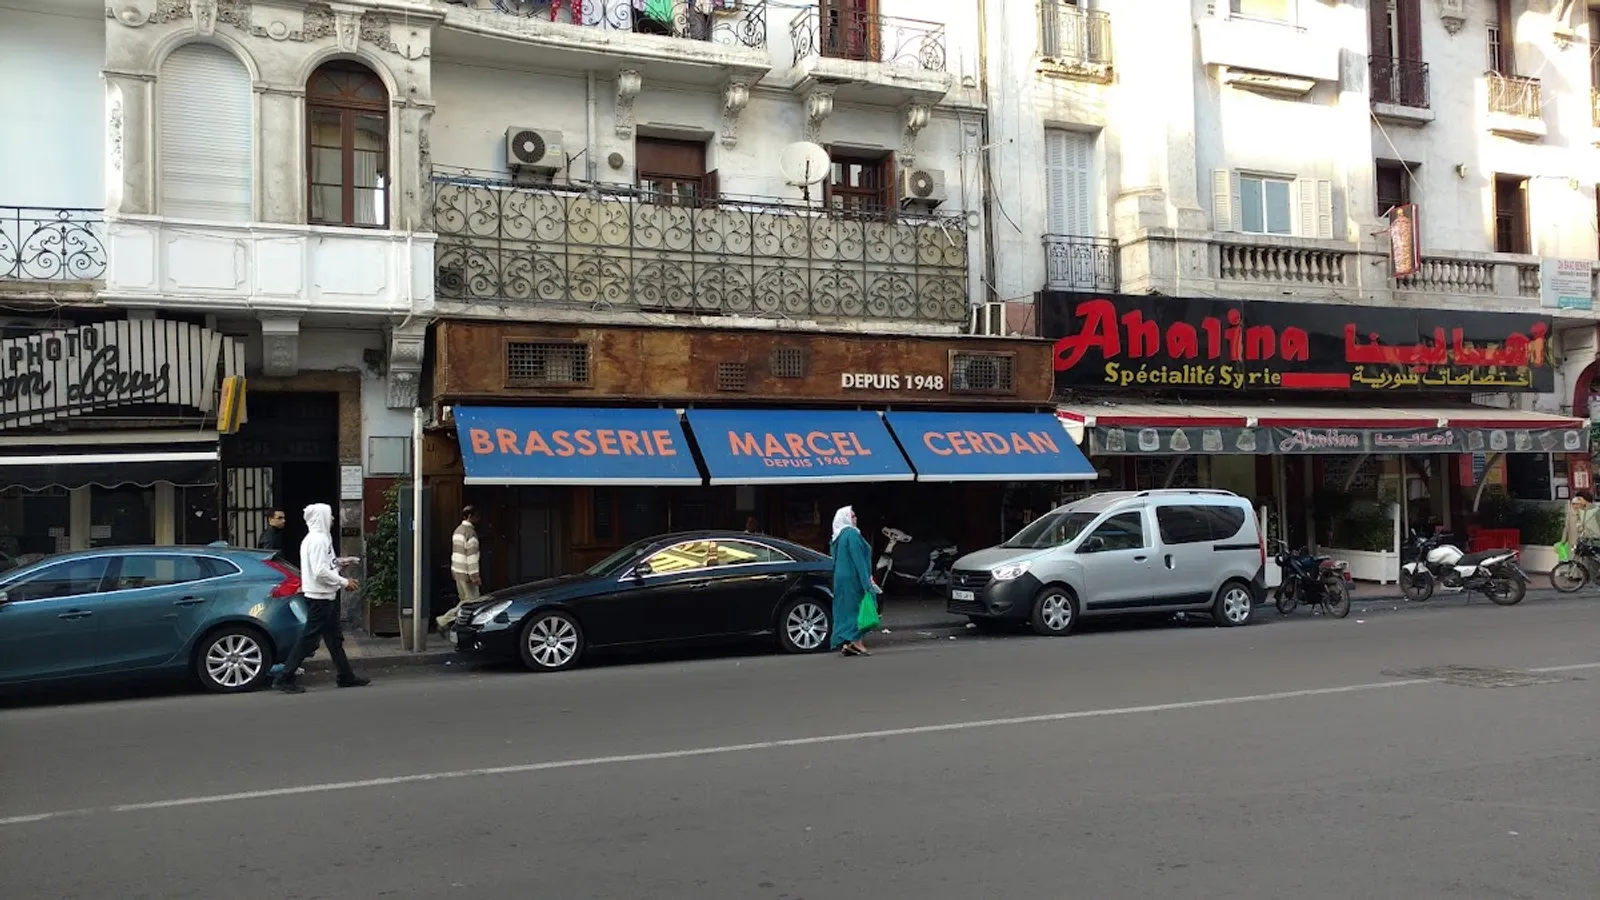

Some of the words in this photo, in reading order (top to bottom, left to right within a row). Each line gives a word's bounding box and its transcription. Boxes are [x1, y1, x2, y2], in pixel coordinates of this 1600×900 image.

[9, 327, 98, 370] PHOTO
[841, 373, 900, 390] DEPUIS
[905, 375, 944, 391] 1948
[1104, 362, 1215, 387] Spécialité
[1218, 365, 1281, 389] Syrie
[1352, 365, 1420, 389] سورية
[469, 428, 677, 457] BRASSERIE
[727, 430, 872, 457] MARCEL
[922, 431, 1060, 456] CERDAN
[763, 457, 813, 469] DEPUIS
[816, 456, 849, 467] 1948
